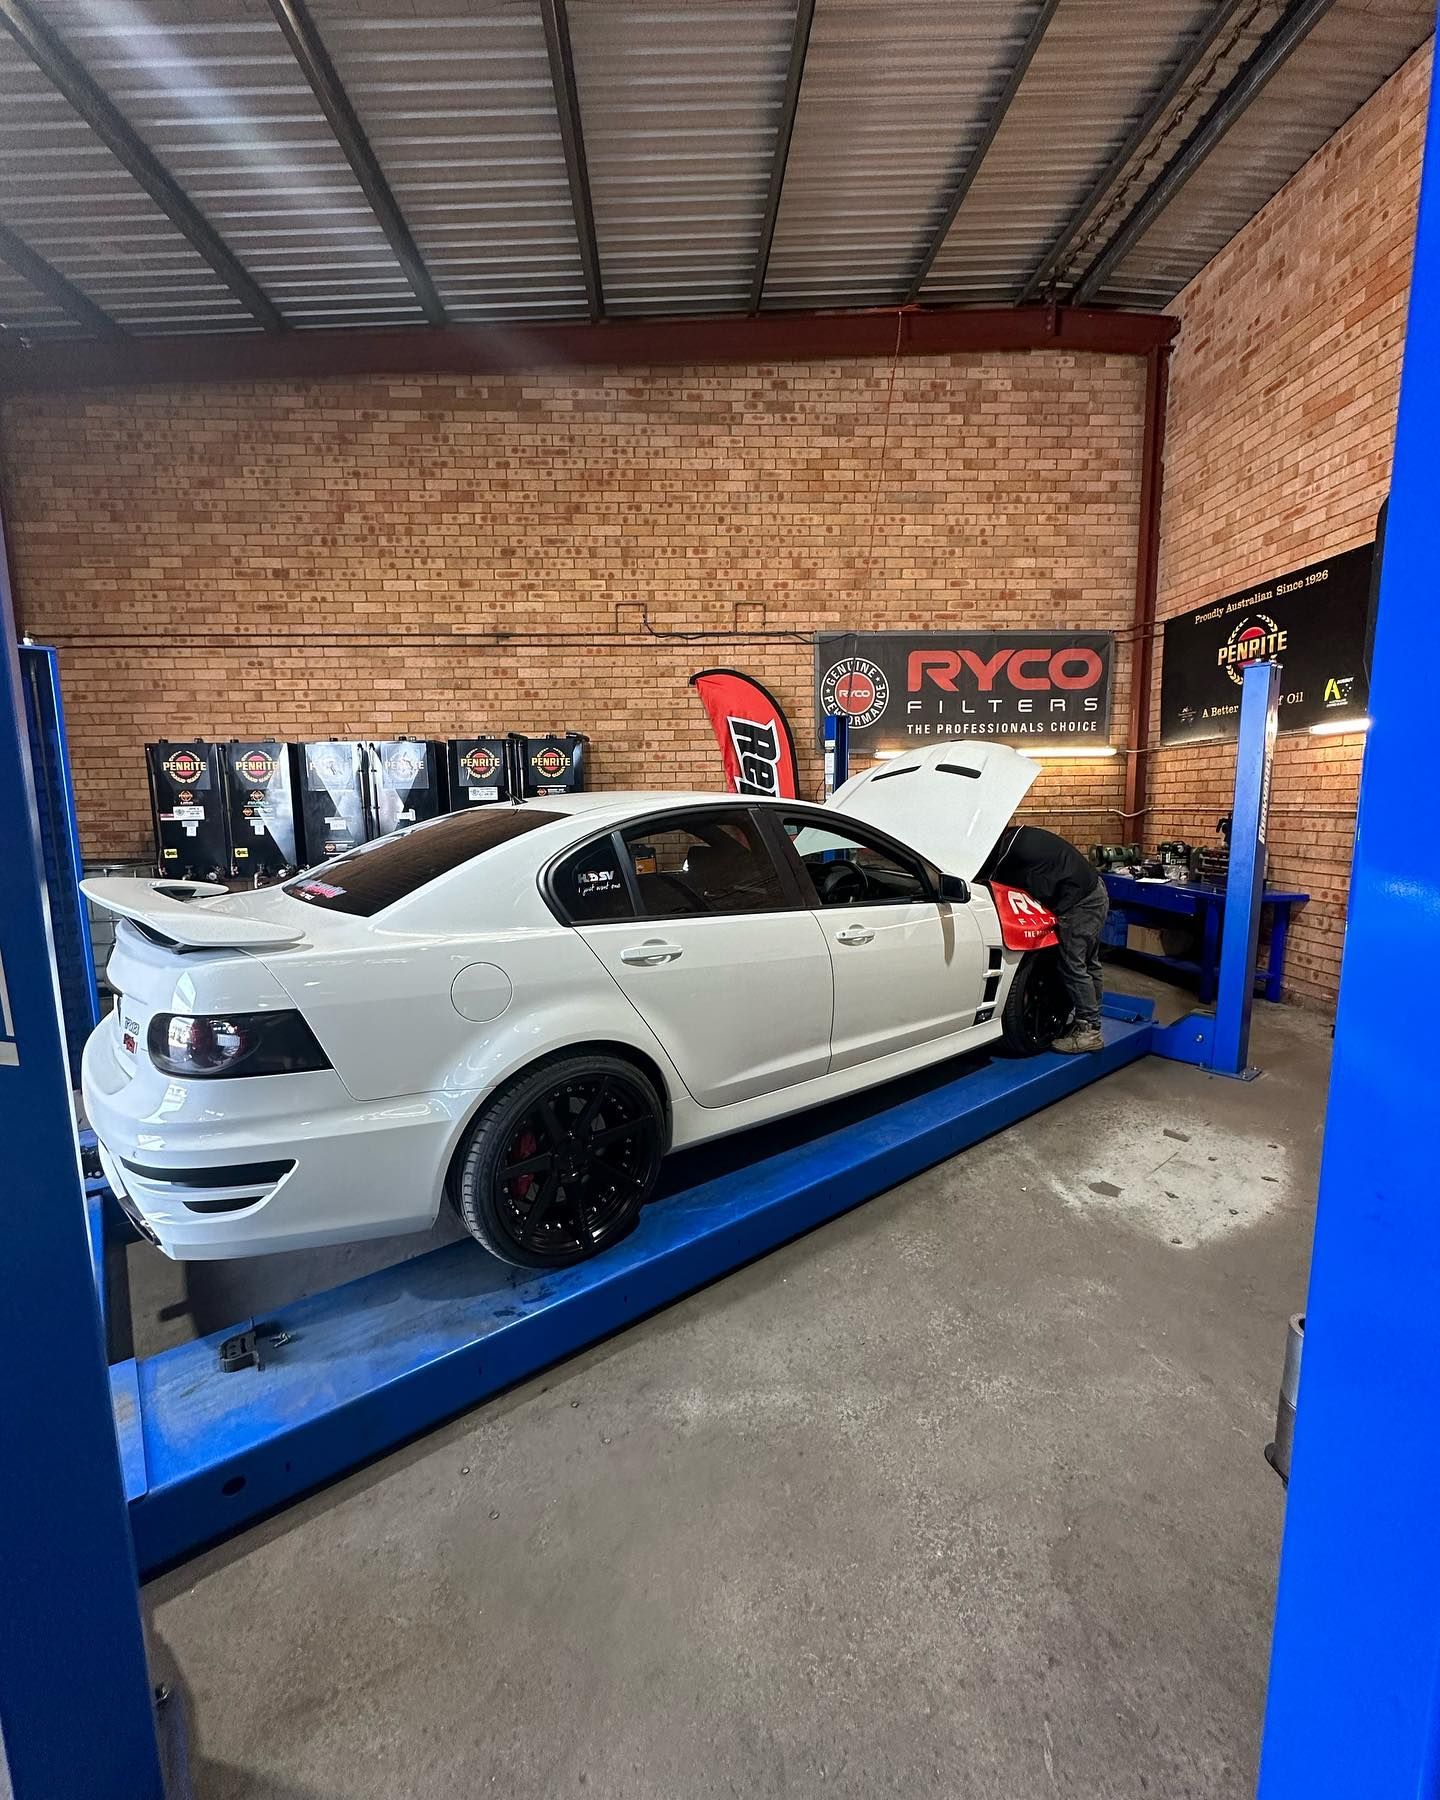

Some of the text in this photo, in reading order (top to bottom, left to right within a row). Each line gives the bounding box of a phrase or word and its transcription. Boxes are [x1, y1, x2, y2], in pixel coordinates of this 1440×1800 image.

[1195, 569, 1329, 624] Proudly Australian Since 1926
[1217, 630, 1288, 666] PENRITE
[907, 648, 1103, 692] RYCO
[838, 689, 871, 698] RYCO
[824, 683, 886, 726] PERORMANCE
[906, 698, 1098, 714] FILTERS
[1202, 708, 1209, 719] A
[1211, 705, 1239, 717] Better
[1286, 691, 1304, 704] Oil
[906, 721, 1097, 734] THE PROFESSIONALS CHOICE
[163, 761, 207, 771] PENRITE
[460, 758, 500, 768] PENRITE
[531, 757, 571, 767] PENRITE
